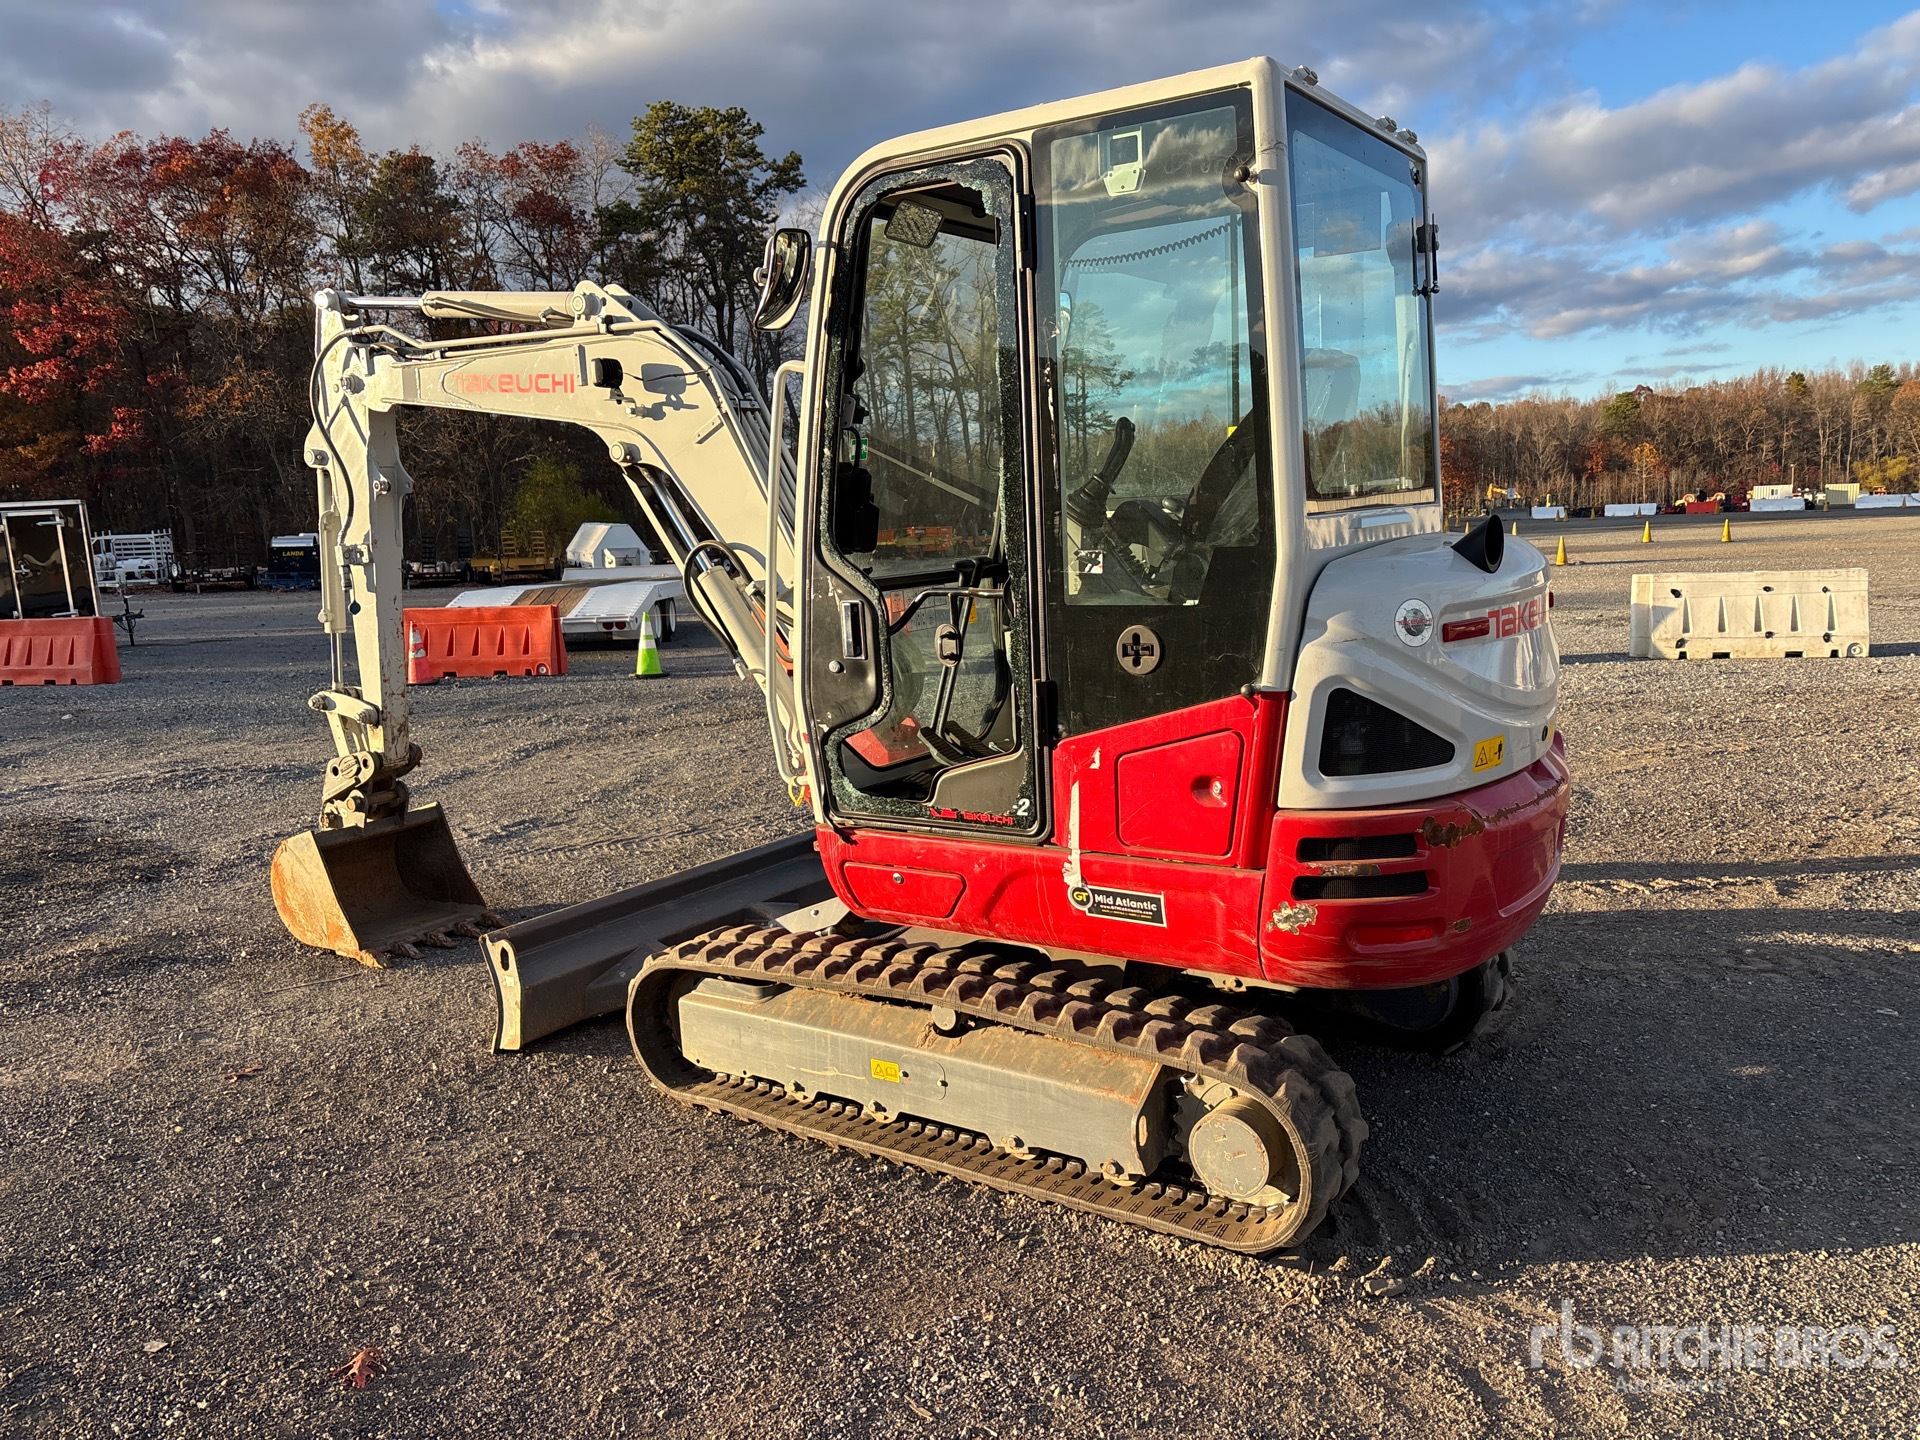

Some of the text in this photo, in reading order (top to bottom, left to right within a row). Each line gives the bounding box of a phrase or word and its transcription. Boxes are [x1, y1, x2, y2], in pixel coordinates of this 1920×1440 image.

[1073, 891, 1089, 902] GT
[1095, 894, 1157, 911] Mid Atlantic
